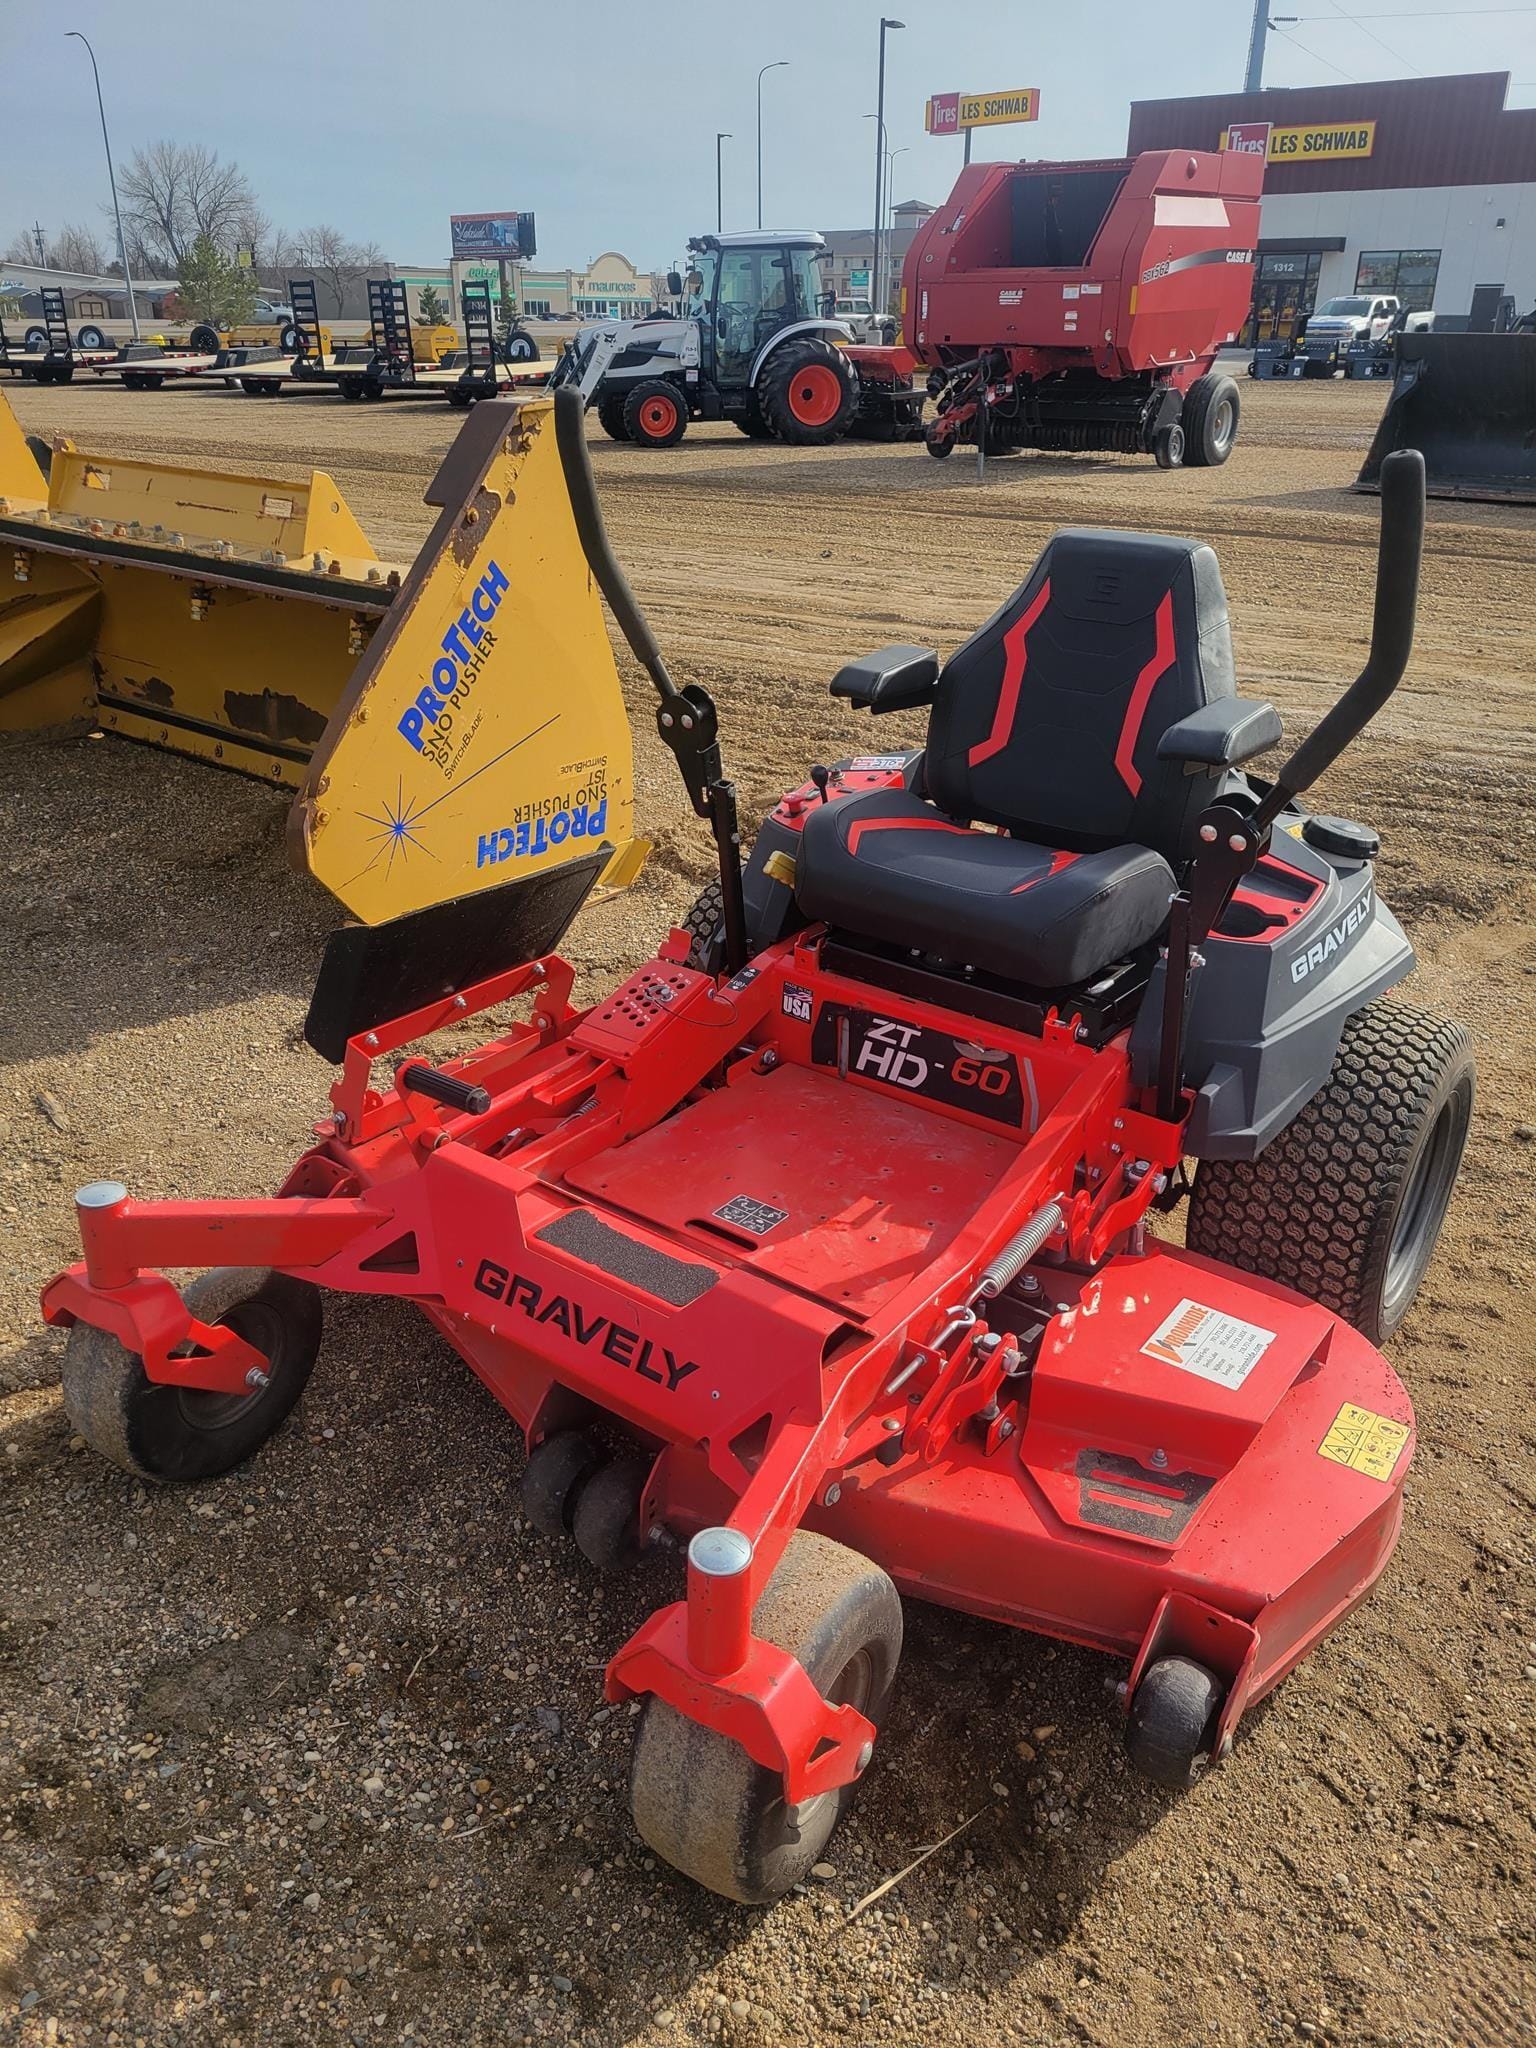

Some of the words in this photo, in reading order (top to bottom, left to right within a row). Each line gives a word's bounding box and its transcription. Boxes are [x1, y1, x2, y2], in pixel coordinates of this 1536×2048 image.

[932, 100, 957, 130] Tires
[962, 102, 980, 120] LES
[984, 96, 1028, 117] SCHWAB
[1231, 131, 1265, 154] Tires
[1271, 135, 1298, 154] LES
[1303, 130, 1369, 152] SCHWAB
[1225, 251, 1244, 263] CASE
[1273, 263, 1295, 272] 1312
[588, 280, 637, 293] maurices
[422, 713, 453, 762] SNO
[450, 630, 498, 711] PUSHER
[575, 783, 607, 806] SNO
[513, 793, 570, 824] PUSHER
[1290, 886, 1373, 984] GRAVELY
[783, 995, 811, 1020] USA
[867, 1018, 922, 1049] ZT
[474, 1258, 701, 1393] GRAVELY
[1162, 1305, 1208, 1348] IRONHIDE
